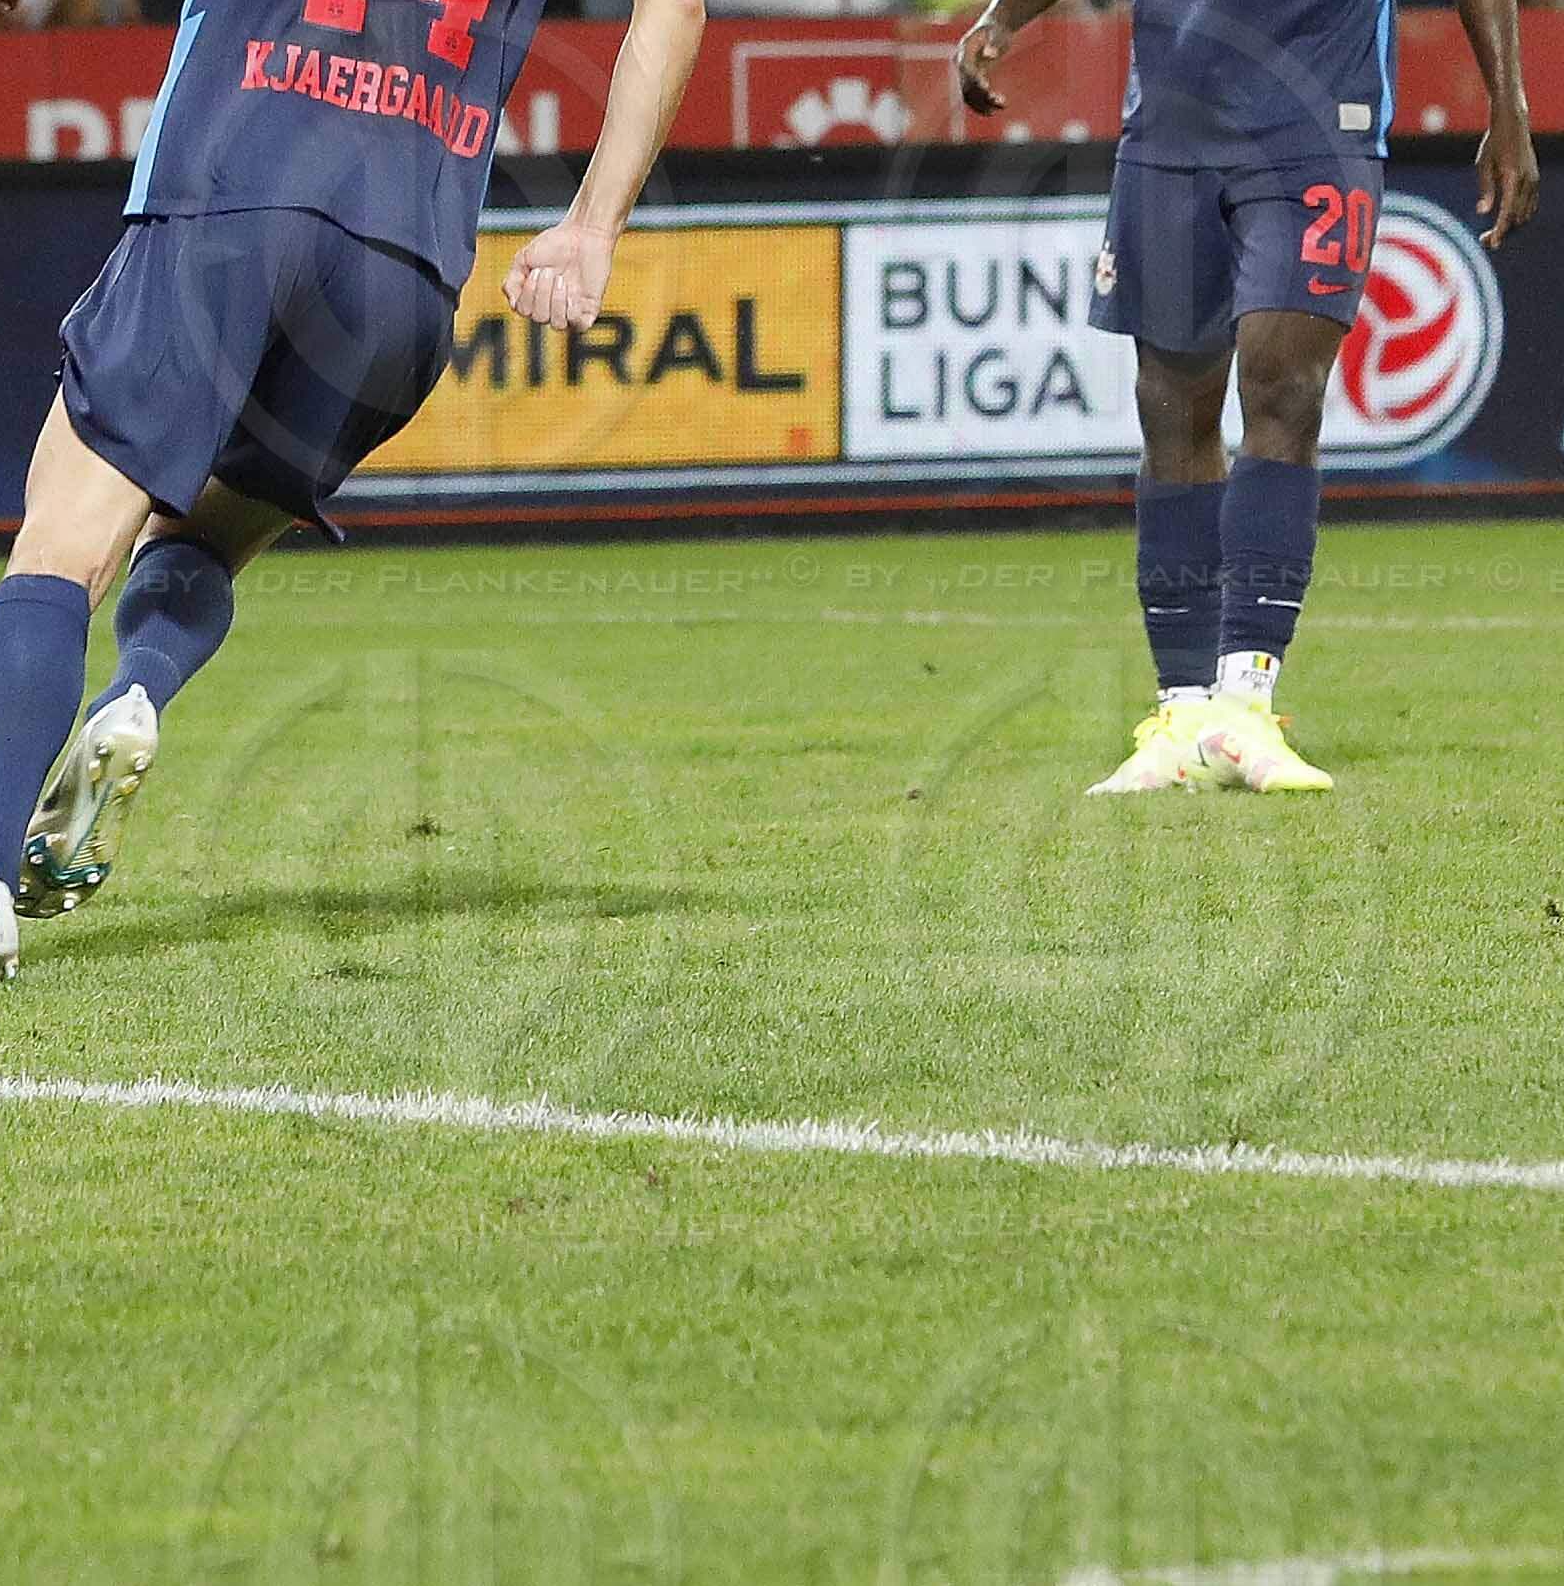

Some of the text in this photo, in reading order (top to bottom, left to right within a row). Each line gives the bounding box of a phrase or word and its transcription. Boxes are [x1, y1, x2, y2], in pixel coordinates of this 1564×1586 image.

[1300, 184, 1375, 273] 20
[881, 260, 1104, 332] BUN
[446, 296, 807, 393] MIRAL
[881, 346, 1094, 420] LIGA
